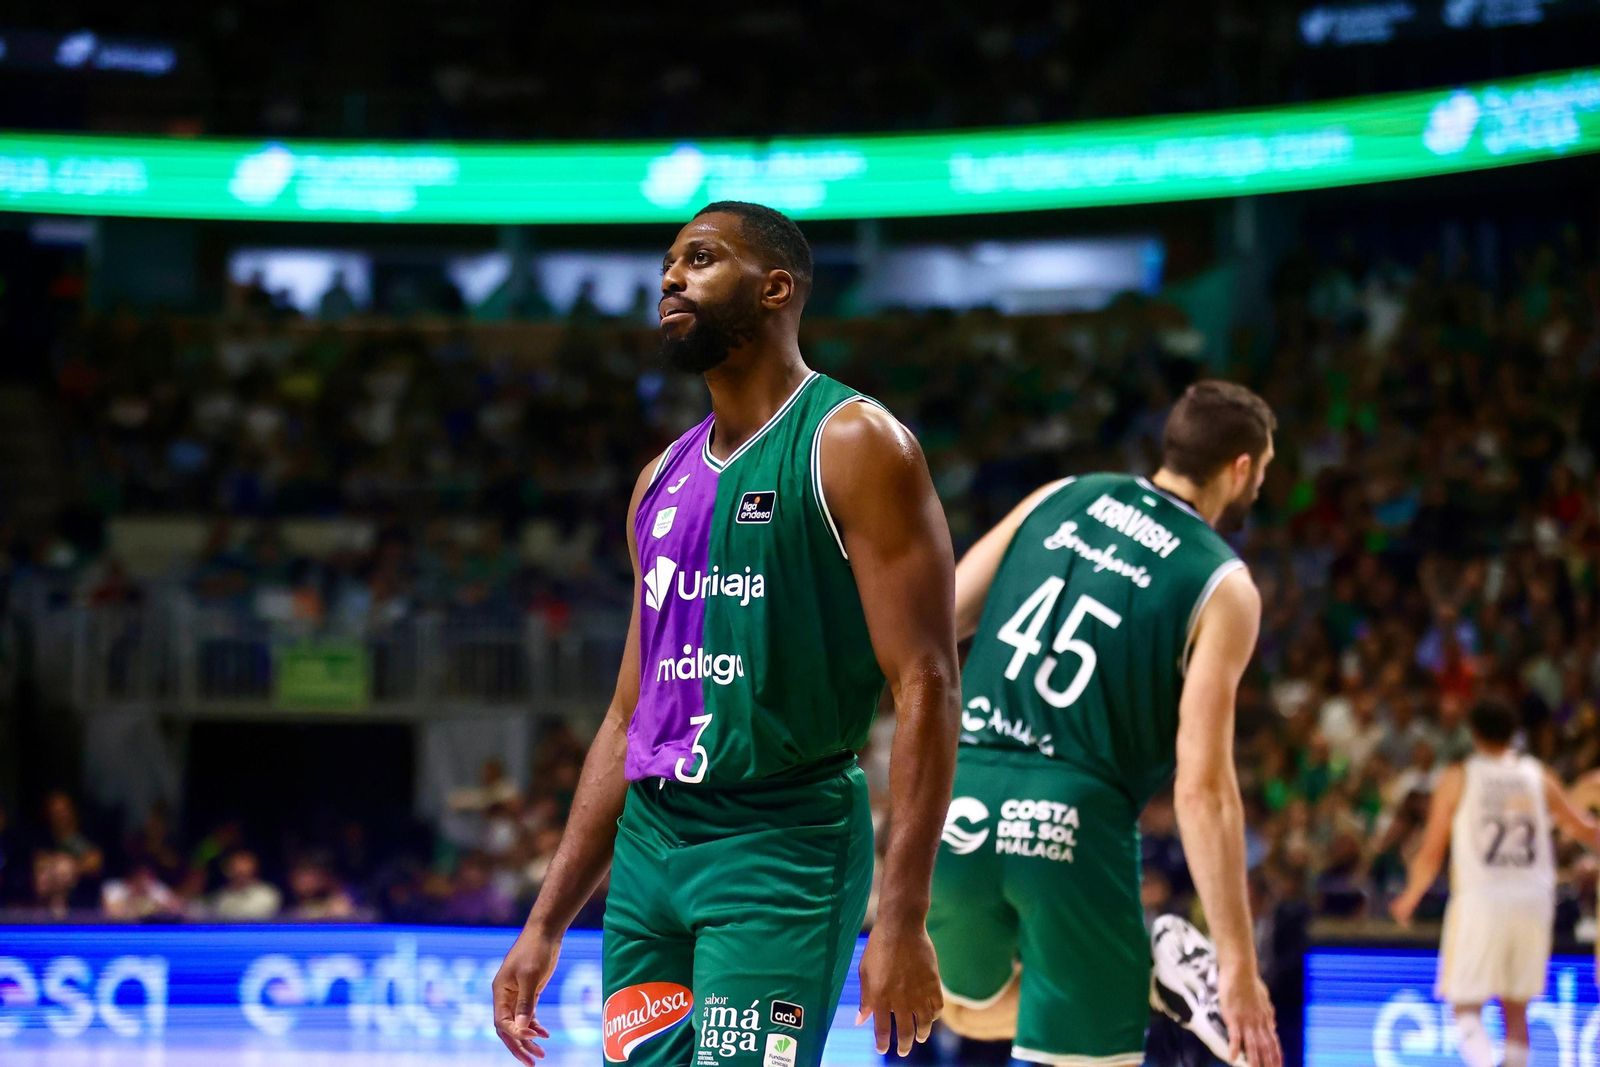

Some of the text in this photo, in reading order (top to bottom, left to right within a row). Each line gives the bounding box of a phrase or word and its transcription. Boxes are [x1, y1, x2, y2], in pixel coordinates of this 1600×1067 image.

[740, 510, 771, 519] endesa
[743, 501, 758, 512] liga
[1086, 493, 1181, 559] KRAVISH
[677, 565, 765, 607] Uniaja
[997, 575, 1122, 708] 45
[674, 713, 713, 784] 3
[1000, 799, 1079, 830] COSTA
[996, 820, 1077, 847] DEL SOL
[705, 993, 729, 1005] sabor
[703, 1000, 761, 1031] a má
[775, 1011, 797, 1024] acb
[699, 1020, 758, 1057] laga
